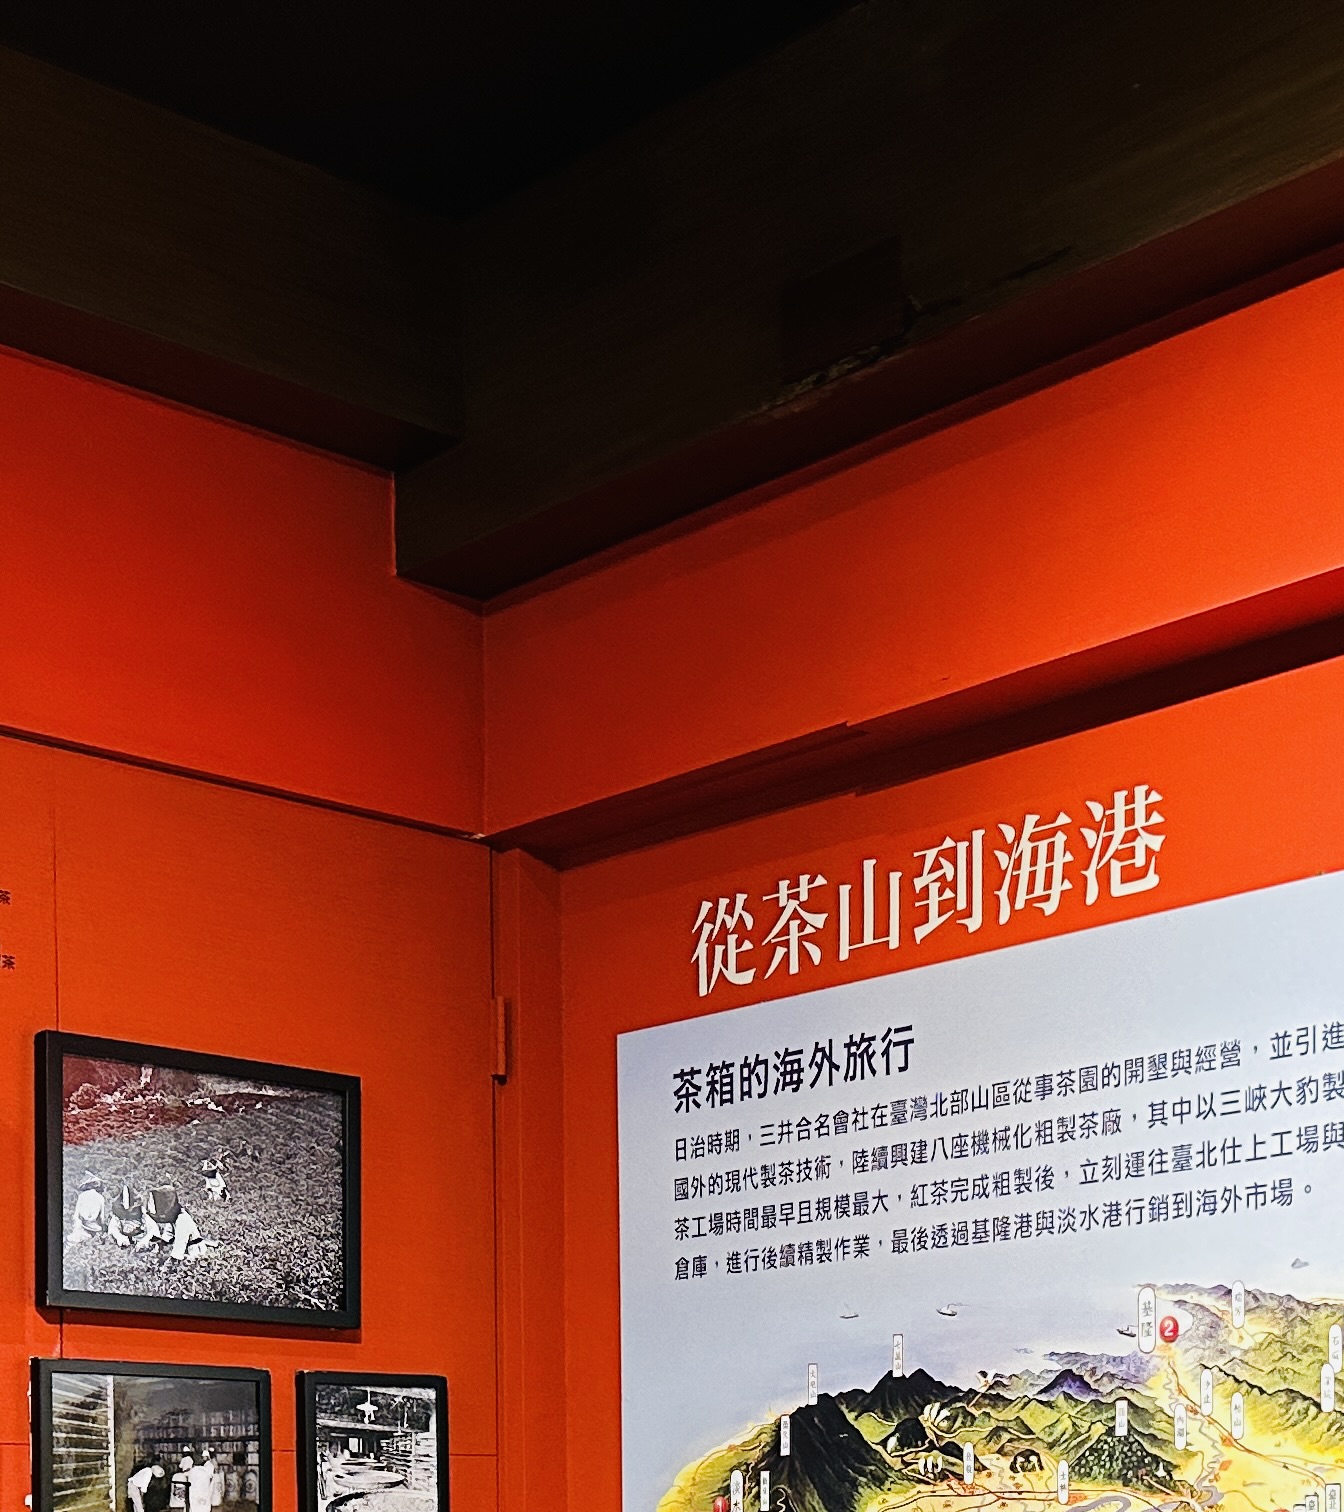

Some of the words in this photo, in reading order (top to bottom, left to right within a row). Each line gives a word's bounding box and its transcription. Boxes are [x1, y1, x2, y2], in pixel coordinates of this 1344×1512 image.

[690, 783, 1165, 998] 從茶山到海港
[673, 1024, 915, 1114] 茶箱的海外旅行
[674, 1177, 1312, 1281] 倉庫，進行後續精製作業，最後透過基隆港與淡水港行銷到海外市場。
[1141, 1300, 1153, 1338] 基隆
[1163, 1320, 1174, 1337] 2
